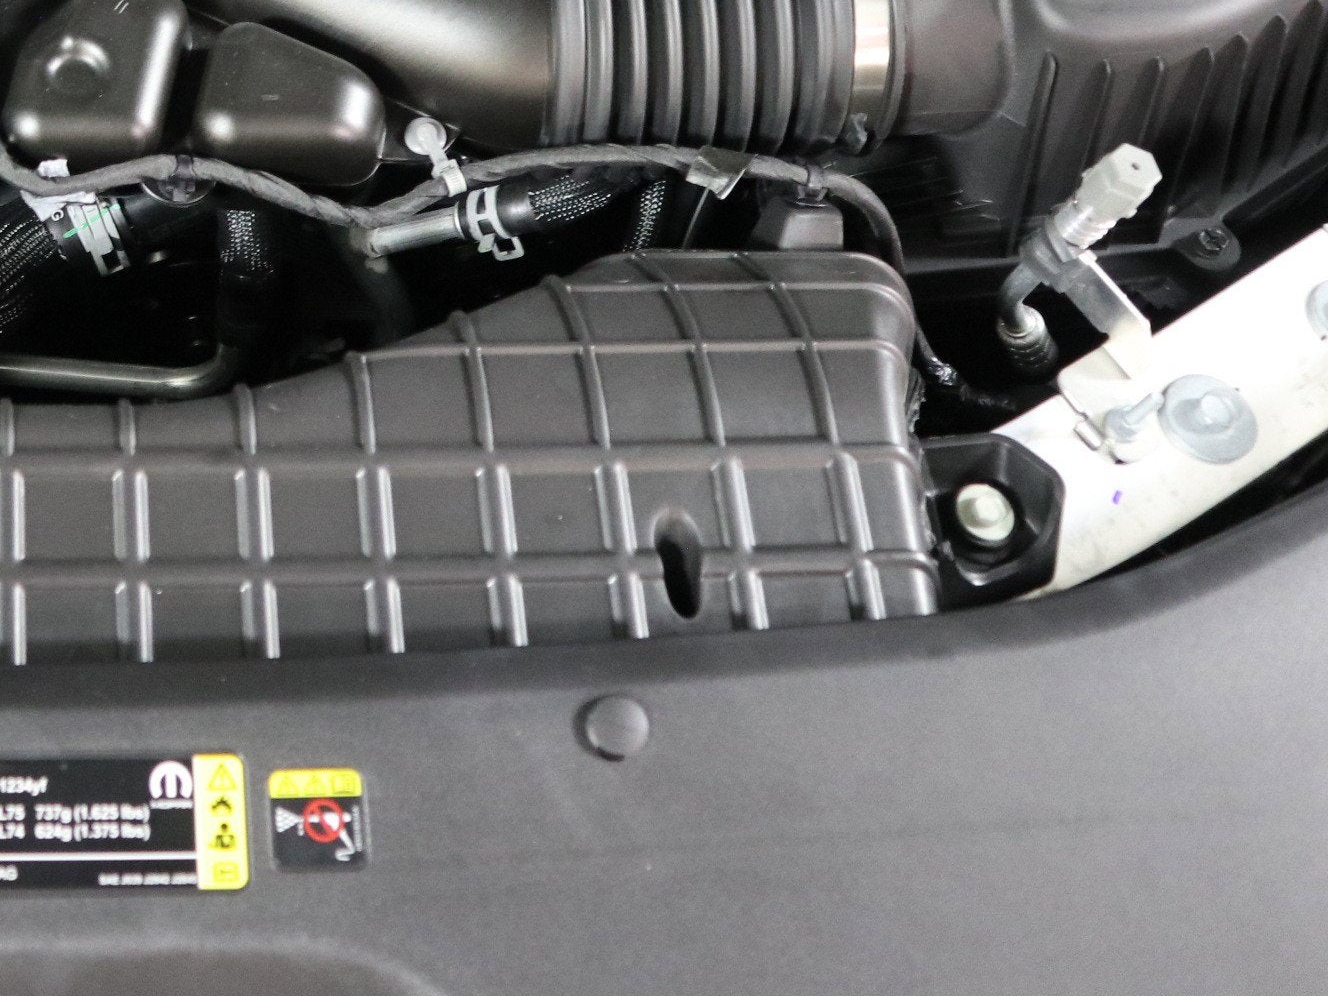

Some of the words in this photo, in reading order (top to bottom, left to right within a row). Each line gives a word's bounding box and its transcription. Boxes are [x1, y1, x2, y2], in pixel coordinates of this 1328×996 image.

[34, 803, 73, 824] 737g
[73, 803, 119, 823] (1.625
[120, 803, 150, 823] lbs)
[34, 822, 73, 842] 624g
[74, 822, 120, 842] (1.375
[120, 822, 151, 842] lbs)
